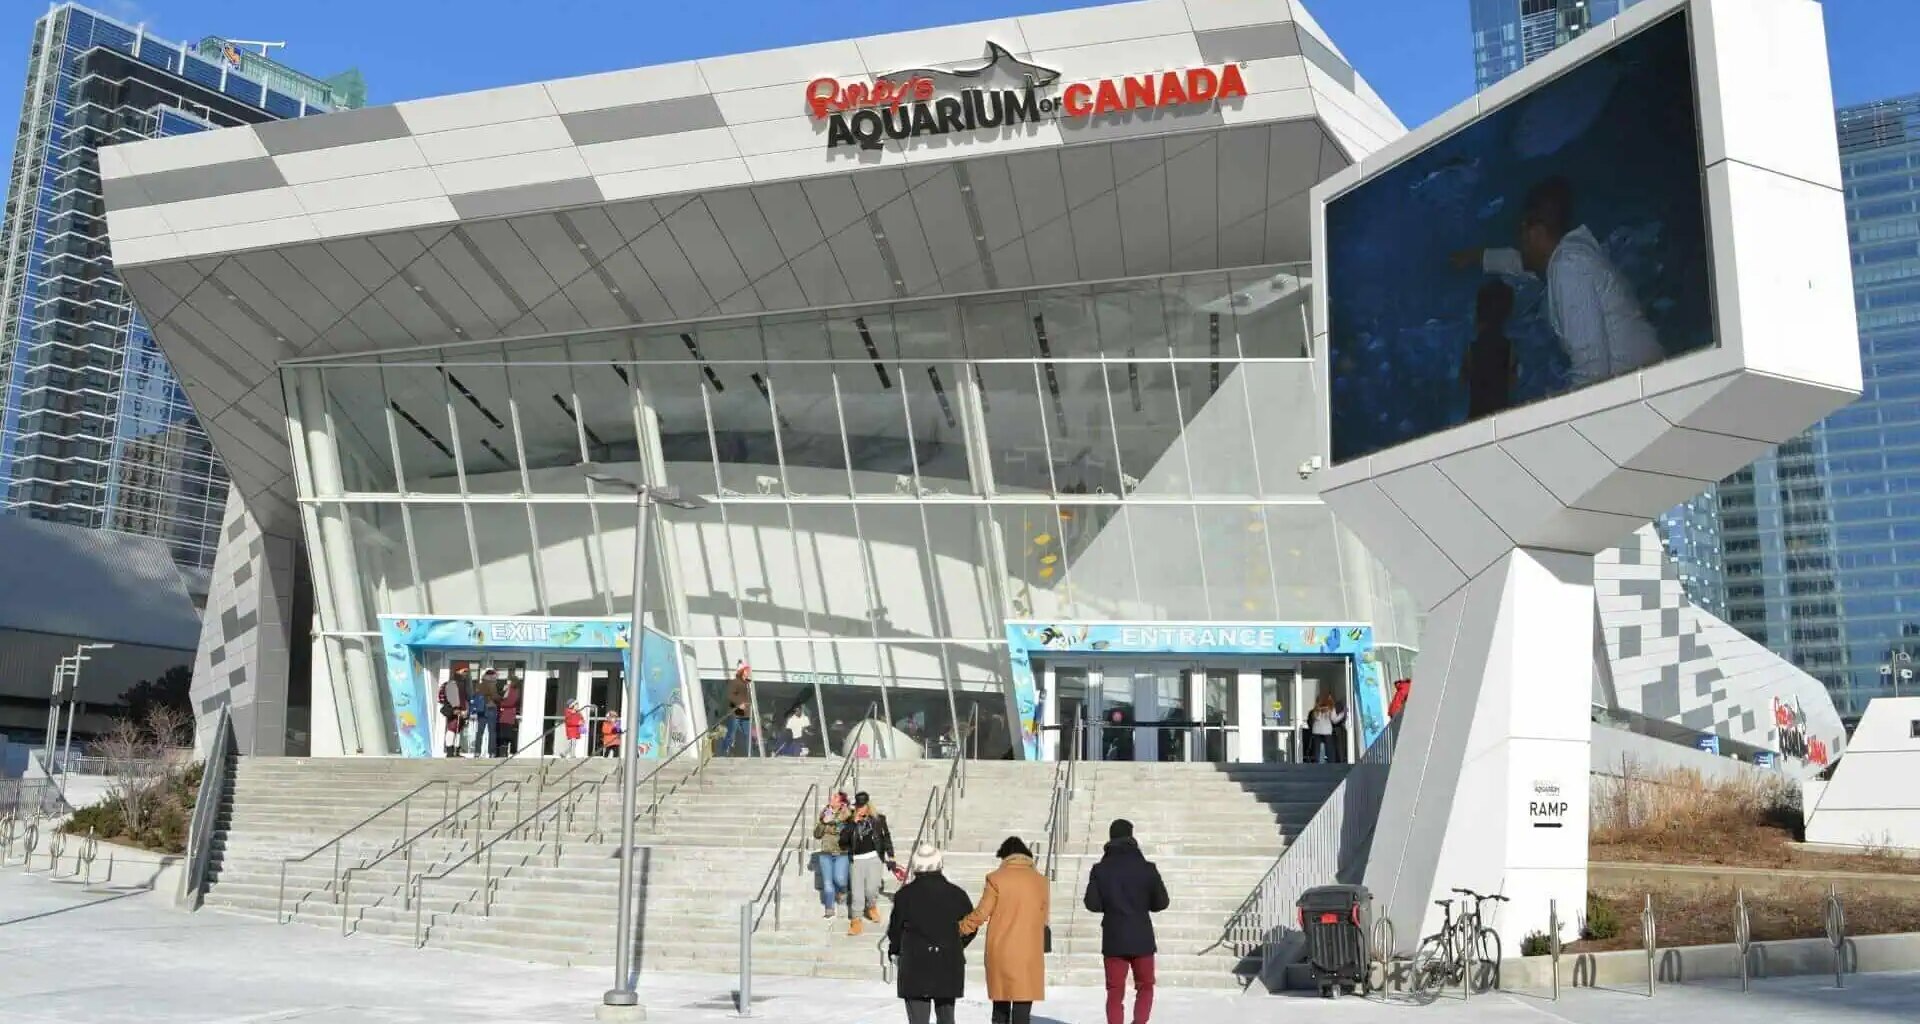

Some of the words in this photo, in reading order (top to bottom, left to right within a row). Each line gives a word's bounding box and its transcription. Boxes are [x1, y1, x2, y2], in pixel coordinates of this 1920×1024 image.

[828, 87, 1041, 150] AQUARIUM
[1039, 96, 1062, 113] OF
[1063, 64, 1248, 117] CANADA
[491, 622, 551, 641] EXIT
[1121, 627, 1275, 647] ENTRANCE
[1529, 801, 1568, 817] RAMP
